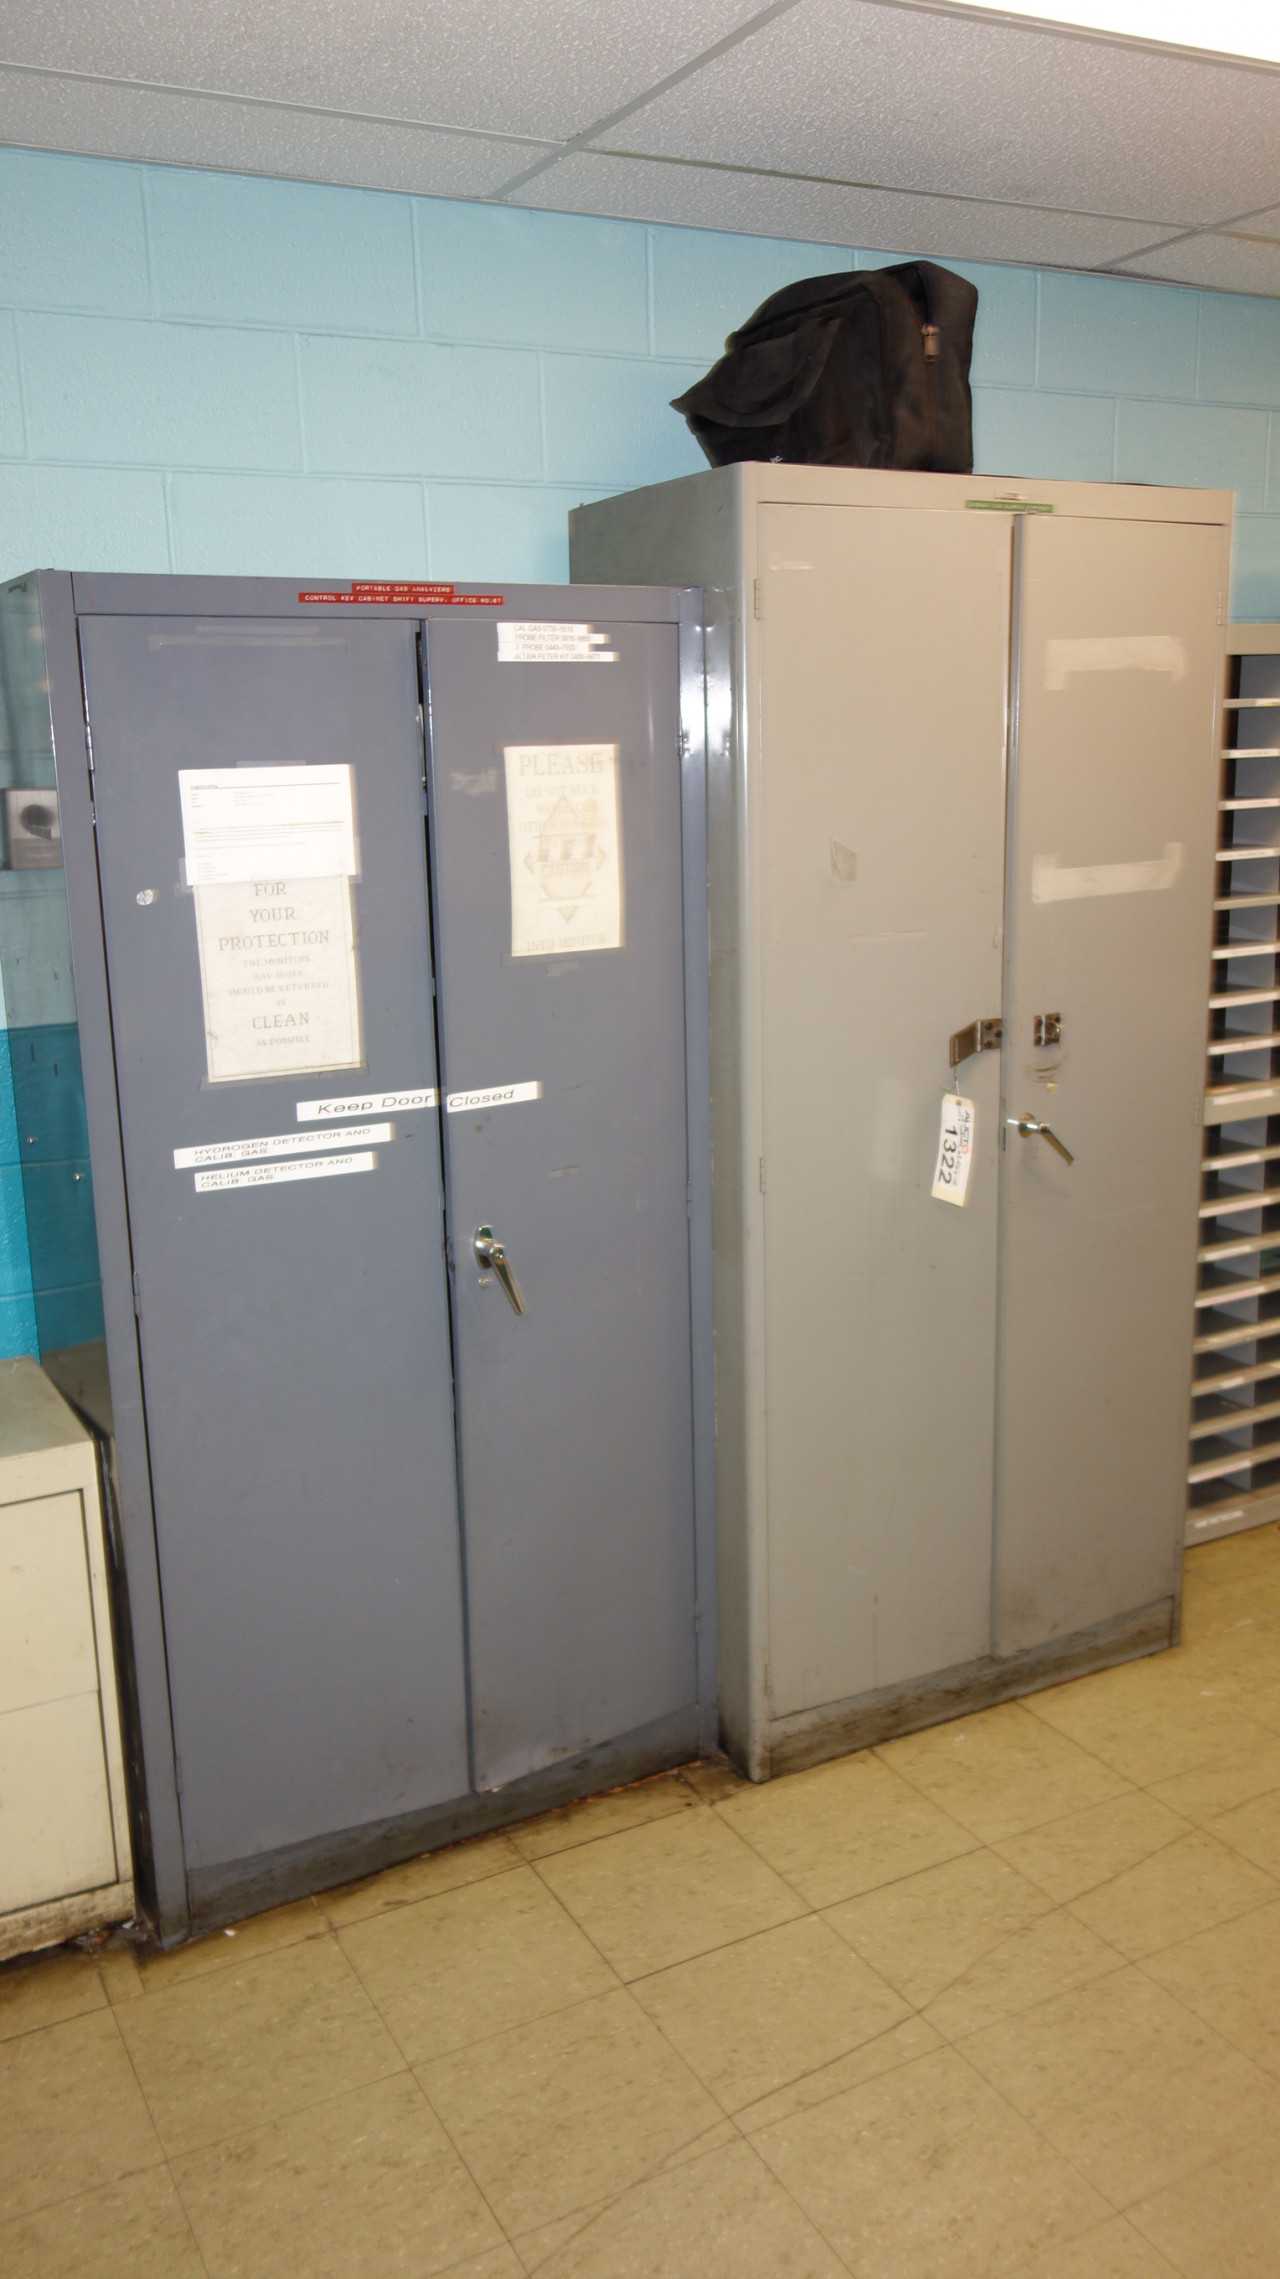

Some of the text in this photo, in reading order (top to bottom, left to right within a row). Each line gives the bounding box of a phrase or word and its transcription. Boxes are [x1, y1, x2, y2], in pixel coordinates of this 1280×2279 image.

[519, 752, 605, 776] PLEASE
[254, 881, 287, 896] FOR
[249, 907, 296, 922] YOUR
[217, 930, 329, 951] PROTECTION
[251, 1012, 310, 1029] CLEAN
[317, 1090, 515, 1114] Keep Door Closed
[193, 1128, 372, 1155] HYDROGEN DETECTOR AND
[240, 1149, 269, 1158] GAS
[938, 1125, 958, 1185] 1322
[200, 1157, 354, 1181] HELIUM DETECTOR AND
[247, 1175, 274, 1184] GAS
